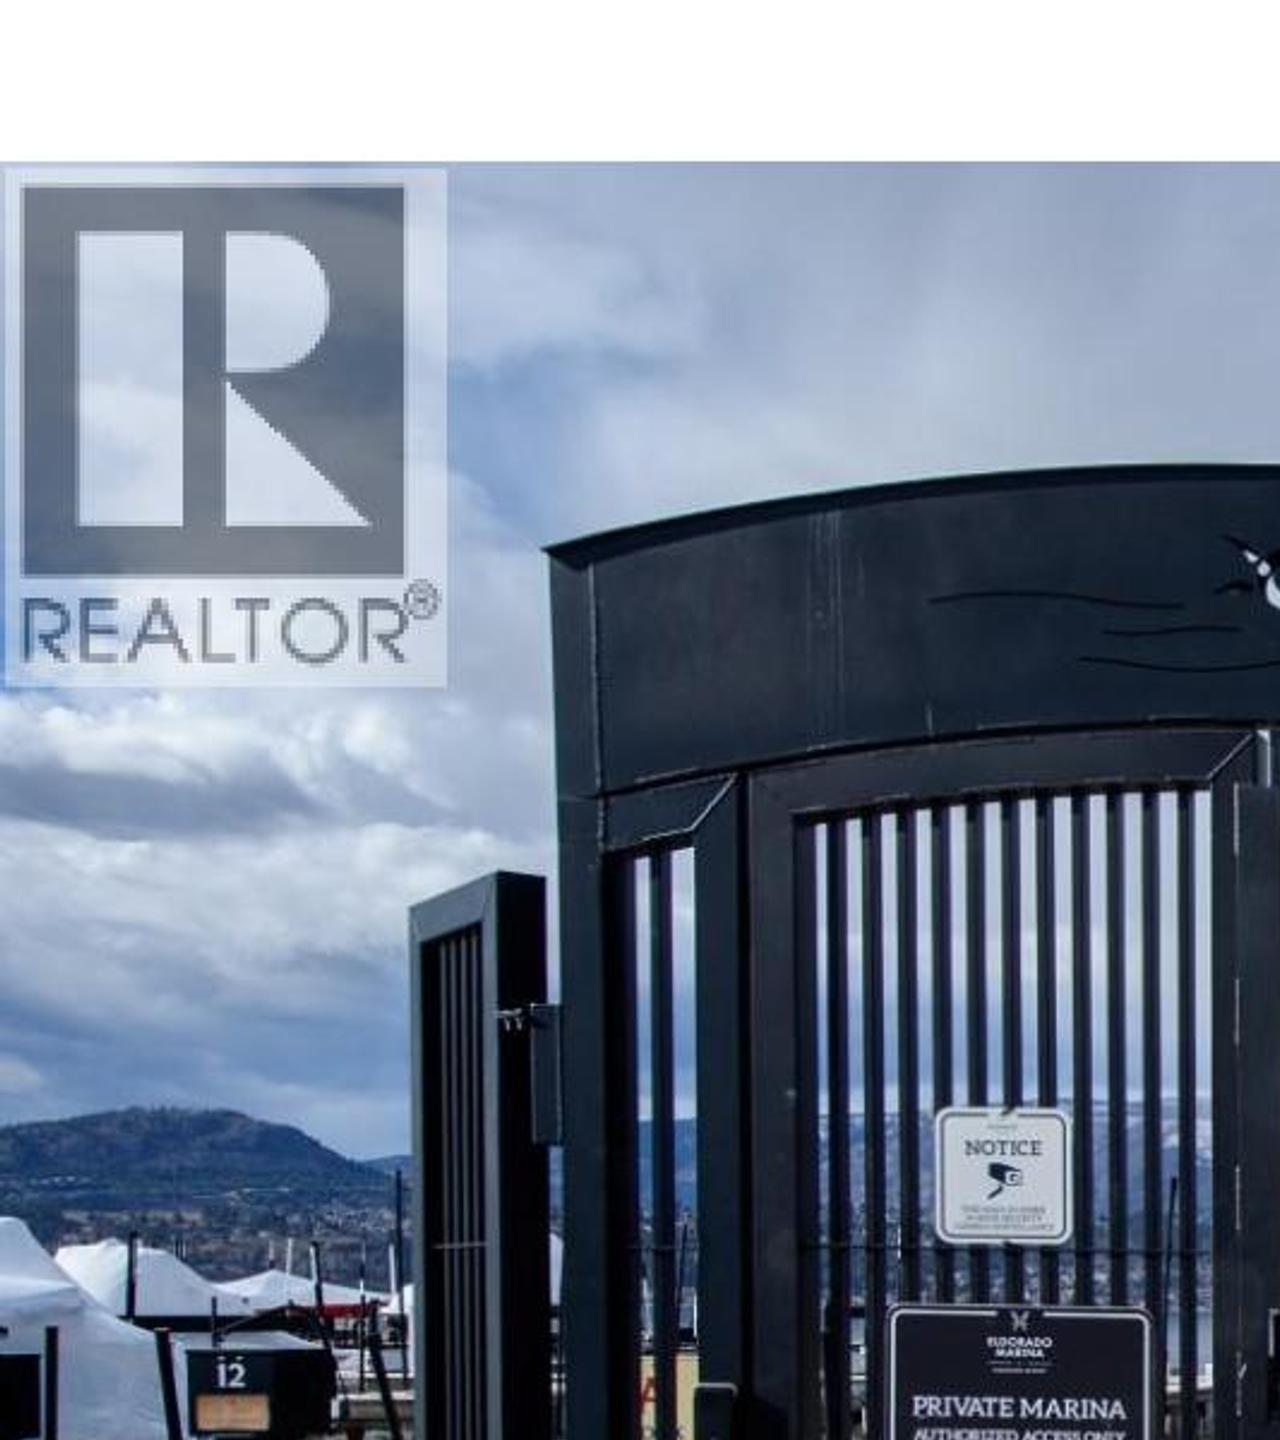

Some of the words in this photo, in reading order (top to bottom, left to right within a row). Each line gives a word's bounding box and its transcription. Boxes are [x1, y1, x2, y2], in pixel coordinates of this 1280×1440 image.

[964, 1139, 1044, 1156] NOTICE
[995, 1348, 1044, 1358] MARINA
[217, 1363, 247, 1389] 12
[912, 1396, 1014, 1418] PRIVATE
[1019, 1398, 1127, 1420] MARINA
